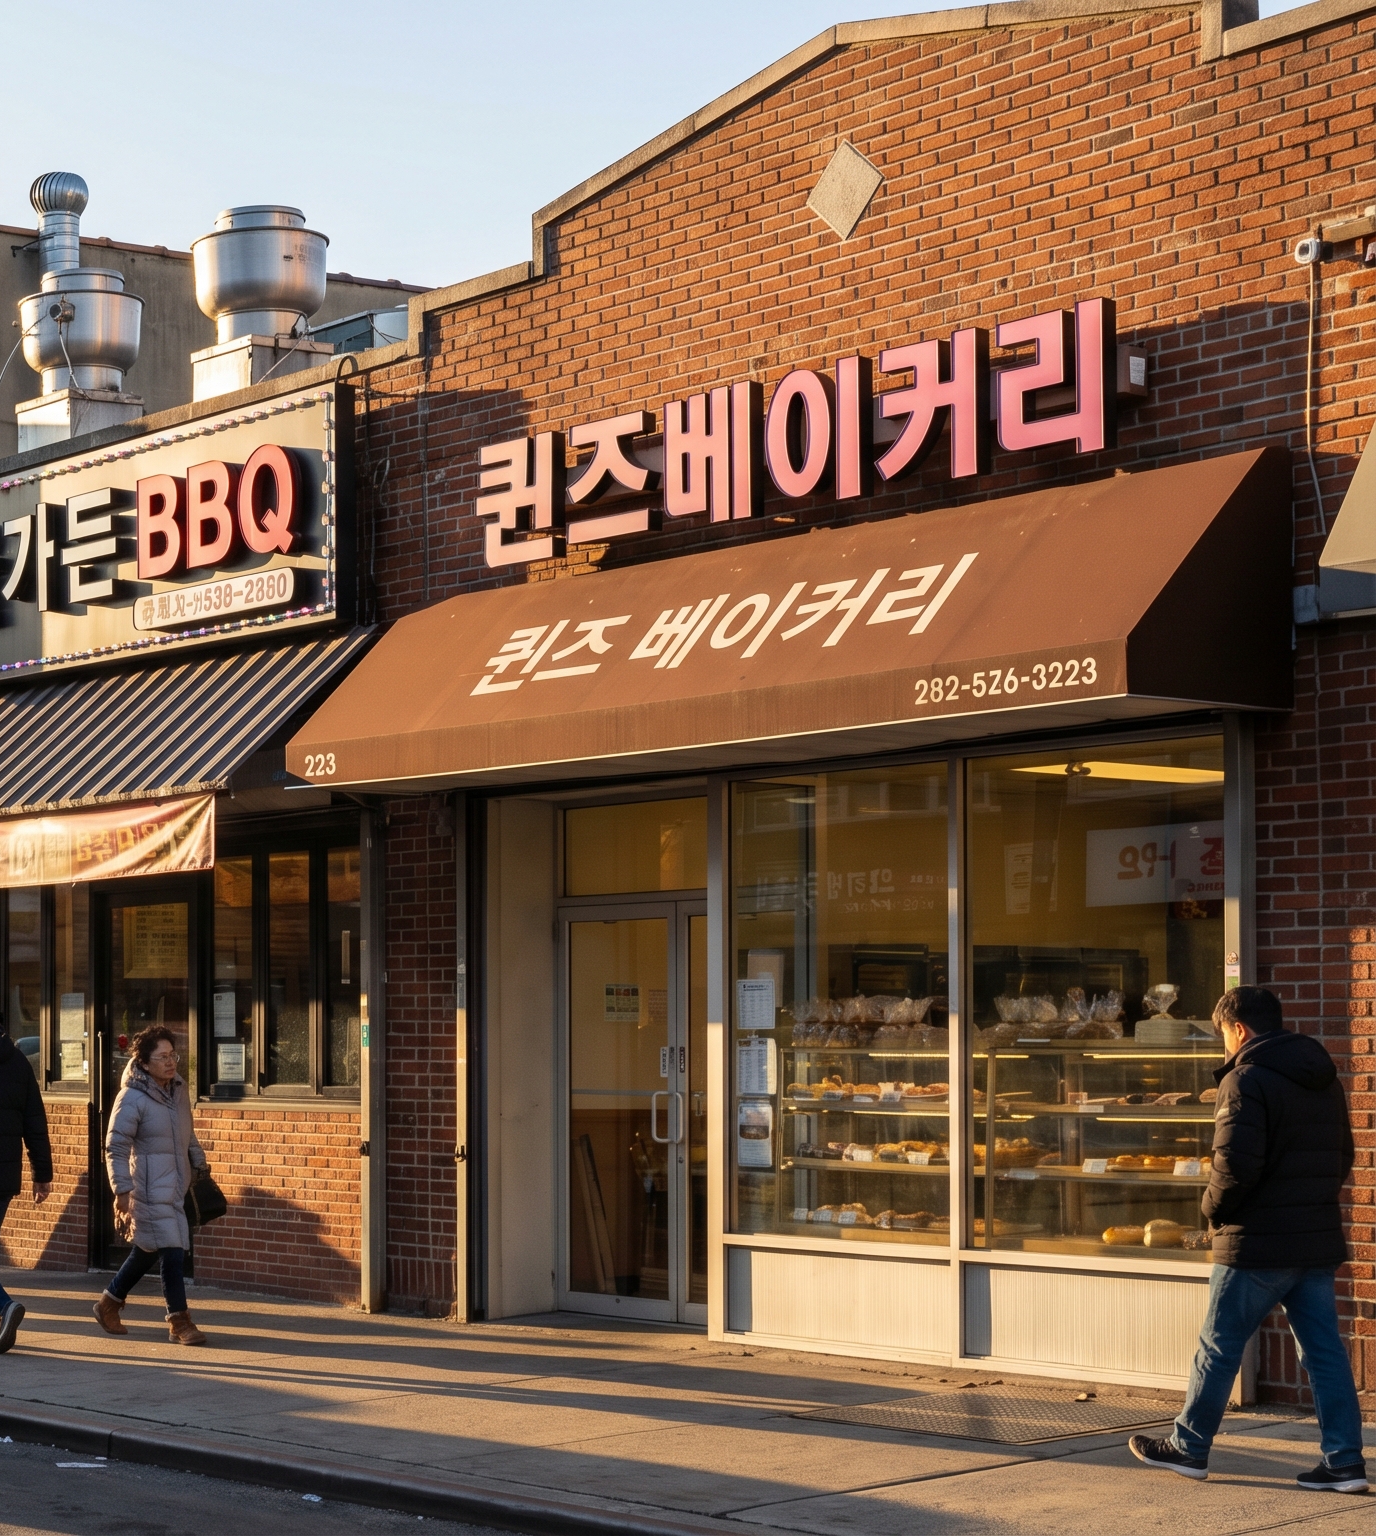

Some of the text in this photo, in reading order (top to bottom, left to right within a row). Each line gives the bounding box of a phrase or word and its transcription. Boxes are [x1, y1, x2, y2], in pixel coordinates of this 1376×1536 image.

[475, 297, 1107, 569] 퀸즈베이커리
[471, 552, 979, 696] 퀸즈 베이커리
[304, 752, 336, 777] 223
